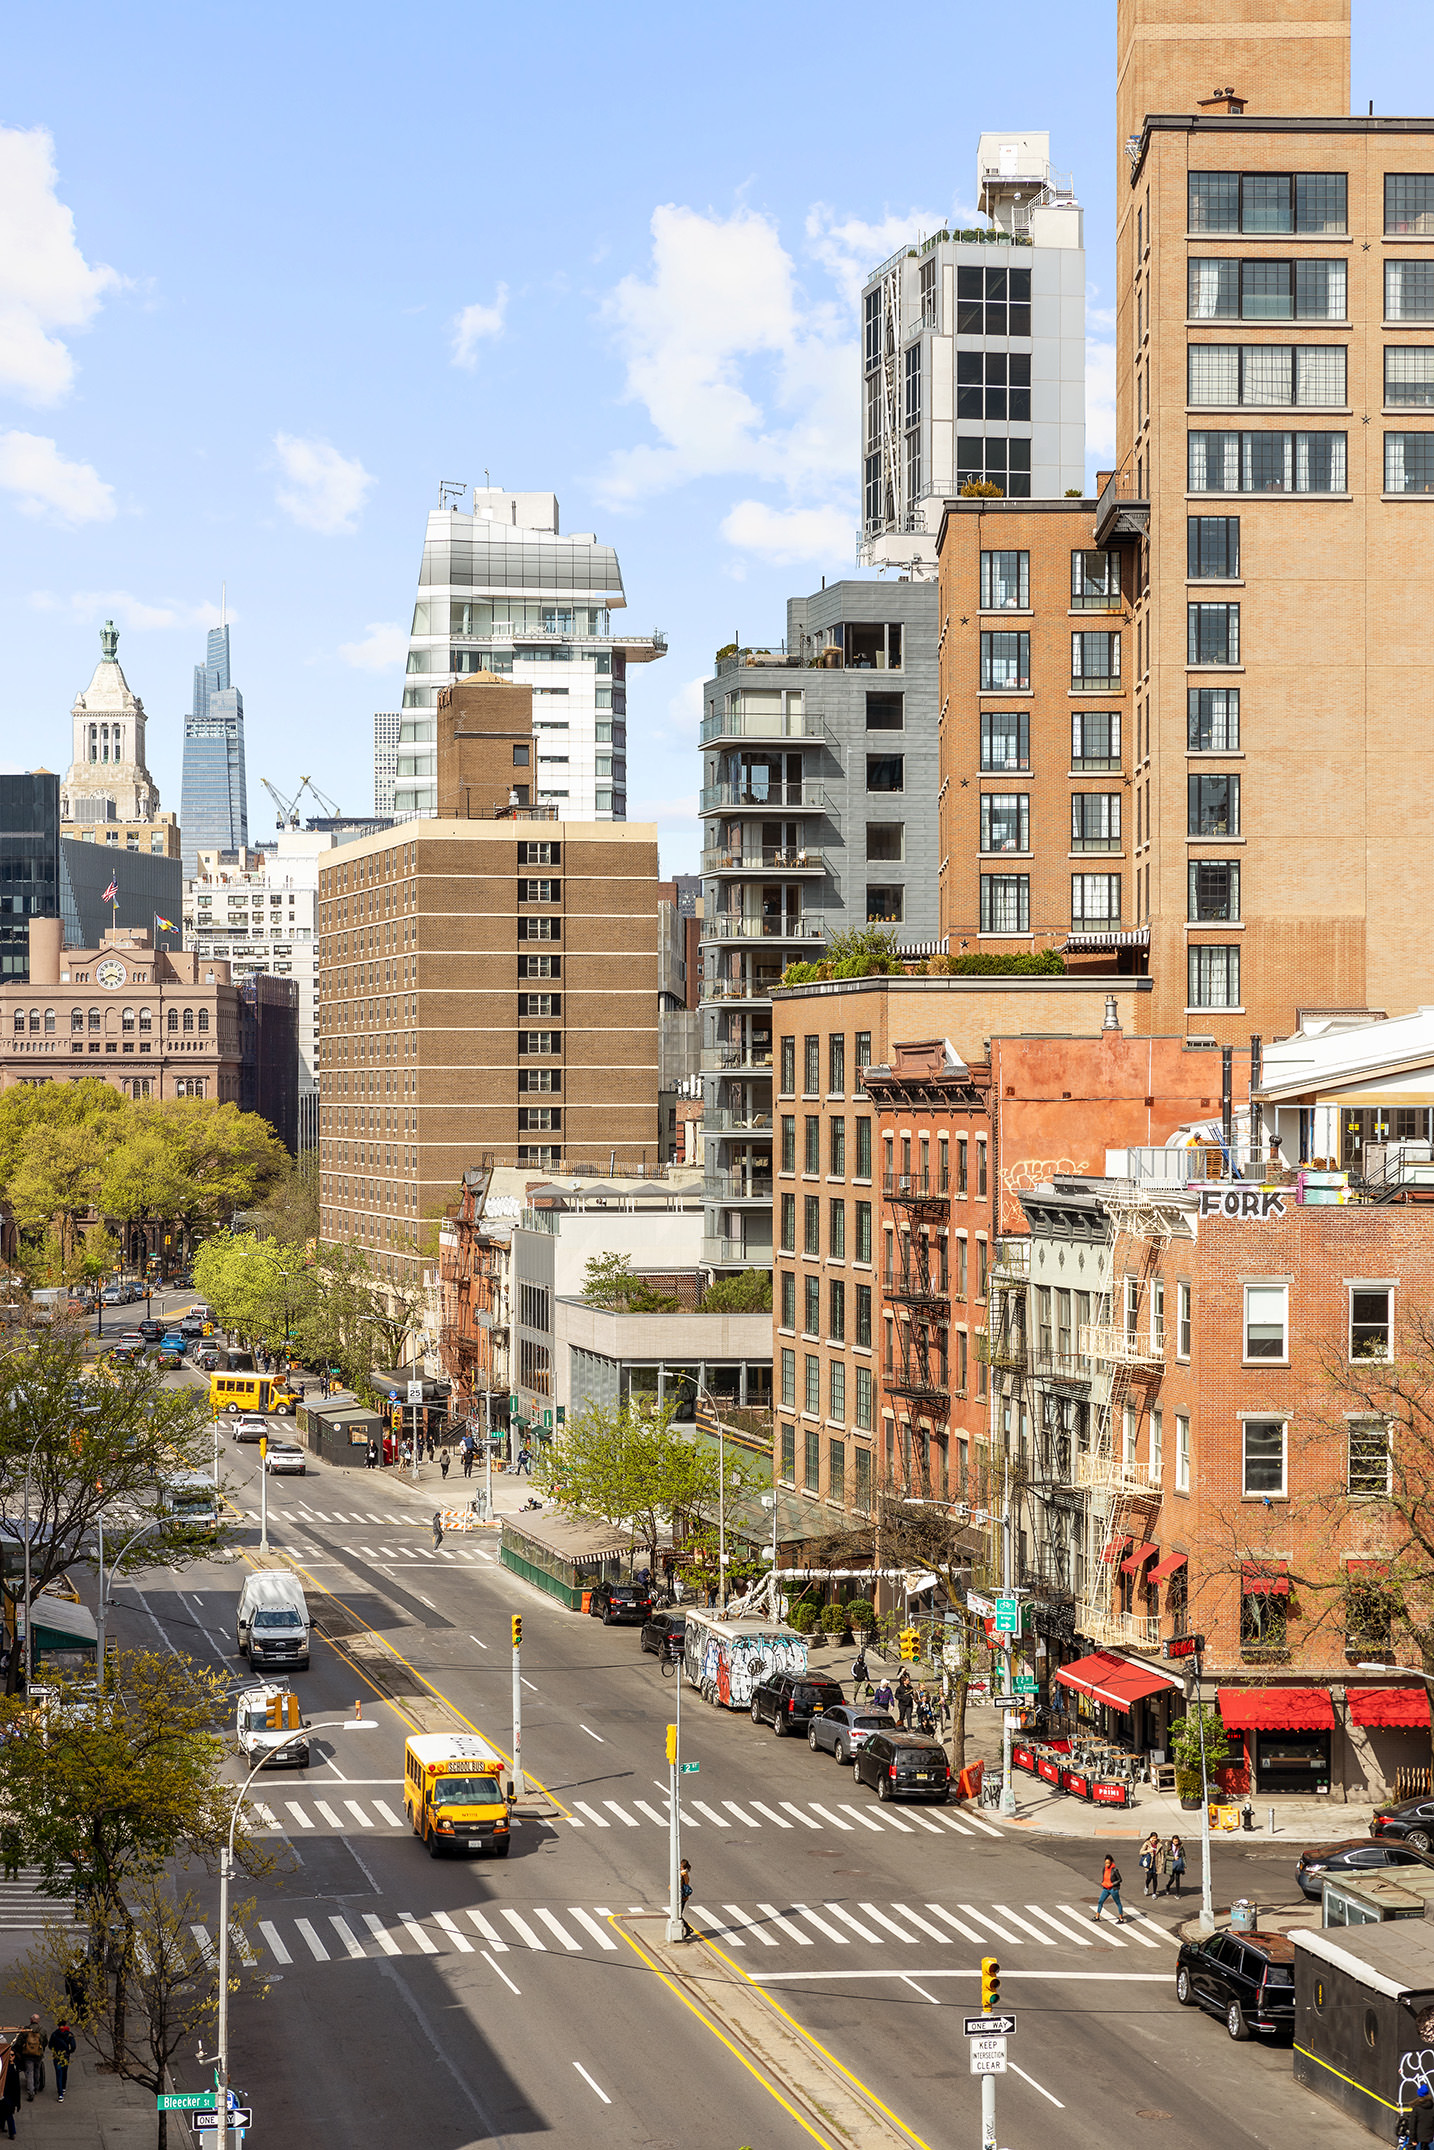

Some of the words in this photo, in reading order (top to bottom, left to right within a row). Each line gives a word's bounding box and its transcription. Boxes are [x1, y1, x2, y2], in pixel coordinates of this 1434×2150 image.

[1201, 1191, 1286, 1218] FORK
[449, 1762, 470, 1772] SCHOOL
[472, 1762, 484, 1771] BUS
[993, 2021, 1008, 2029] WAY
[164, 2097, 200, 2108] Bleecker
